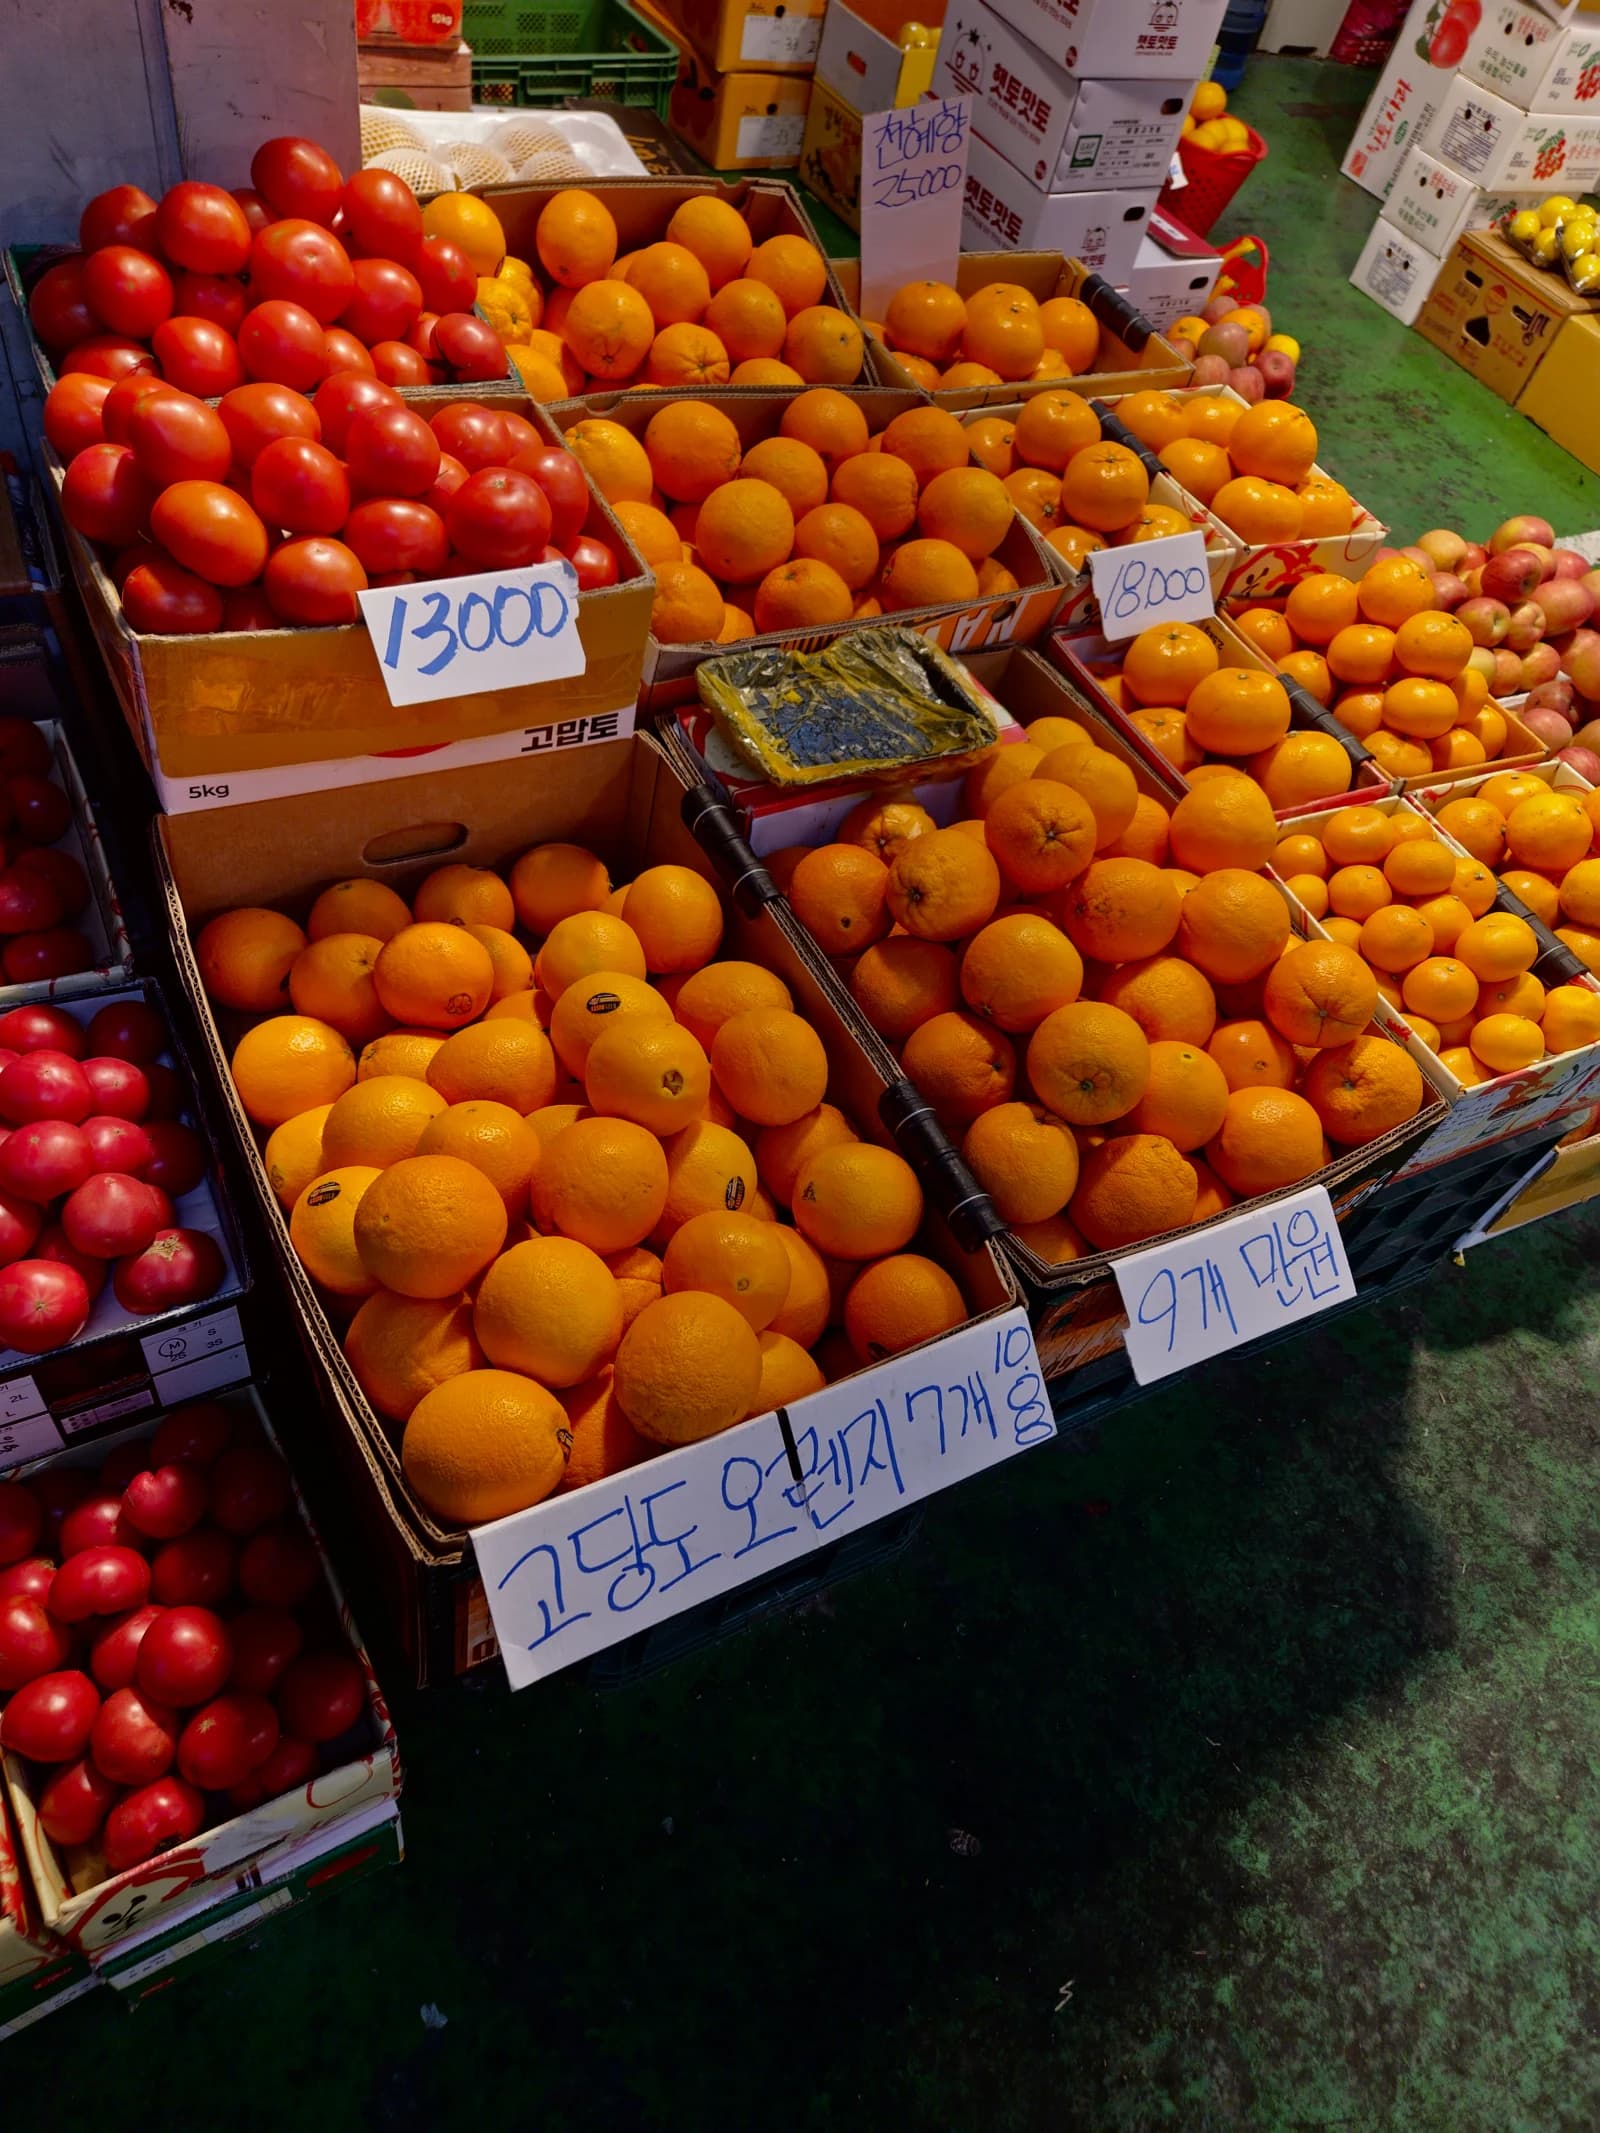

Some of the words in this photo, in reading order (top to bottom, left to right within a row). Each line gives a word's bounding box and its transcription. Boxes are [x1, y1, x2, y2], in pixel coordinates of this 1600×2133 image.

[1136, 34, 1179, 50] 햇토맛토
[988, 63, 1052, 134] 햇토맛토
[873, 101, 969, 170] 천혜향
[963, 174, 1023, 245] 햇토맛토
[384, 581, 569, 676] 13000
[521, 712, 619, 752] 고맙토
[188, 783, 231, 800] 5kg
[1138, 1259, 1238, 1352] 9개
[1239, 1210, 1340, 1307] 만원
[498, 1480, 721, 1651] 고당도
[721, 1397, 905, 1560] 오렌지
[905, 1370, 998, 1455] 7개
